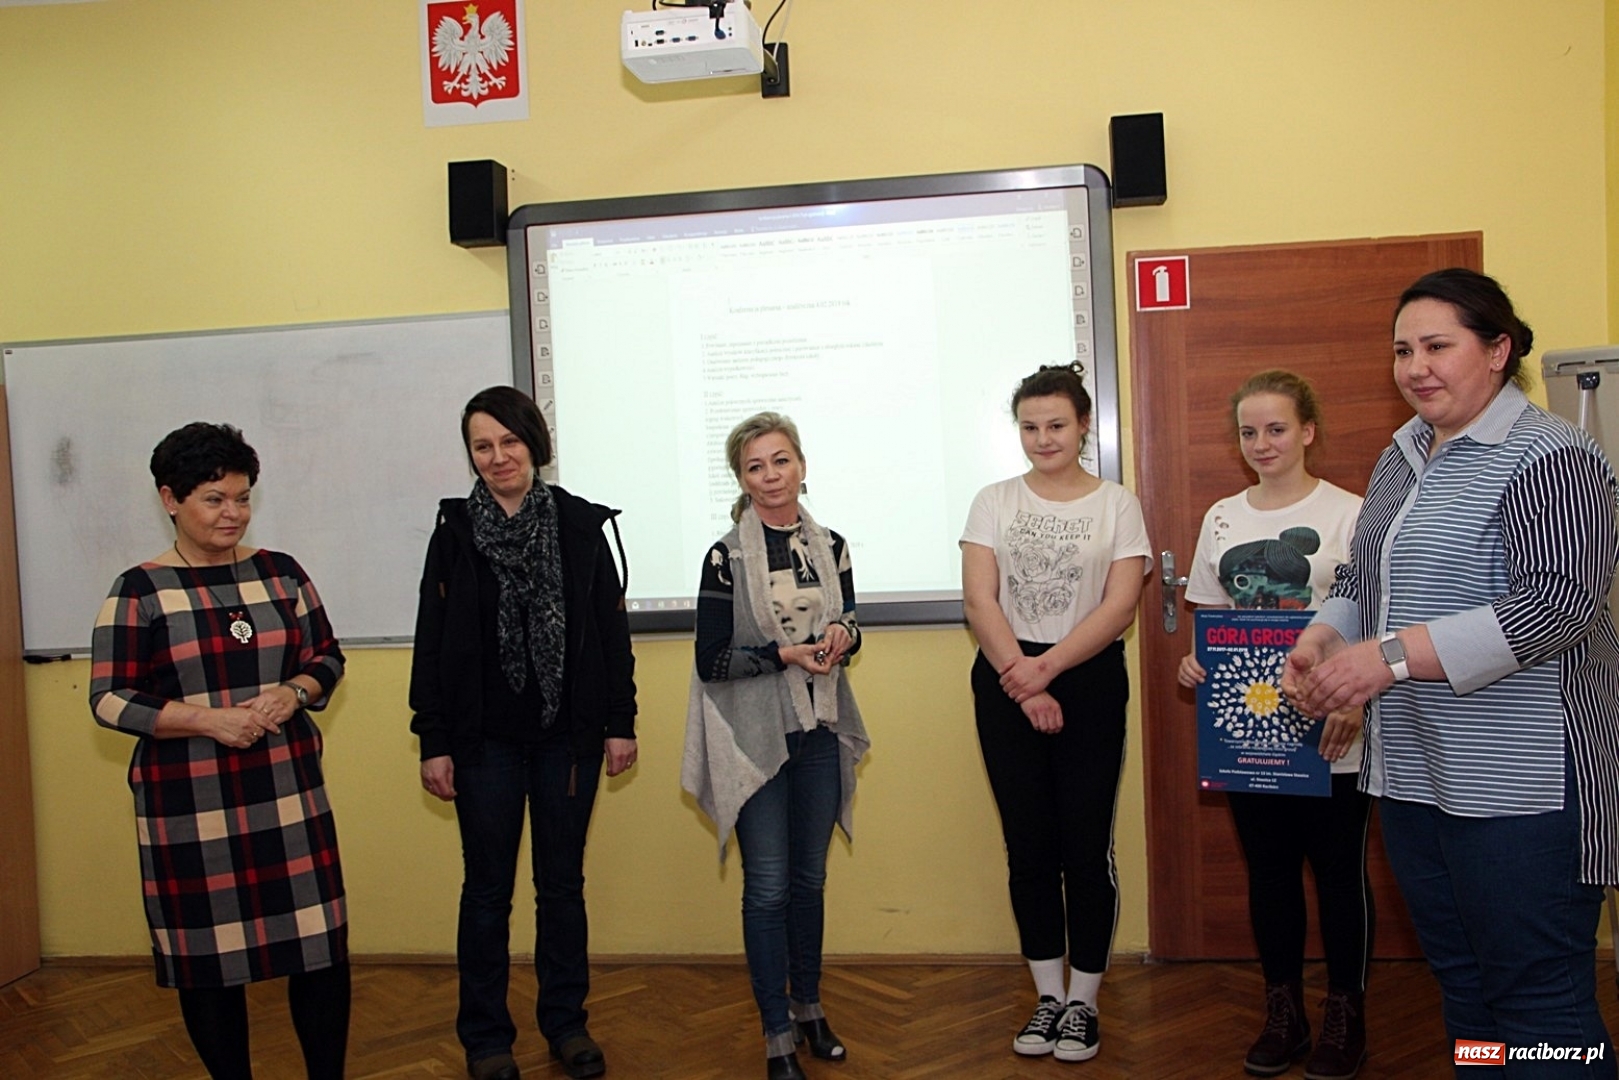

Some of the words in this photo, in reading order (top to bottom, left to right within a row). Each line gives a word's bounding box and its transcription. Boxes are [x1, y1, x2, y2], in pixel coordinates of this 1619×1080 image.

[1020, 528, 1036, 537] CAN
[1207, 625, 1249, 645] GÓRA
[1237, 757, 1285, 766] GRATULUJEMY
